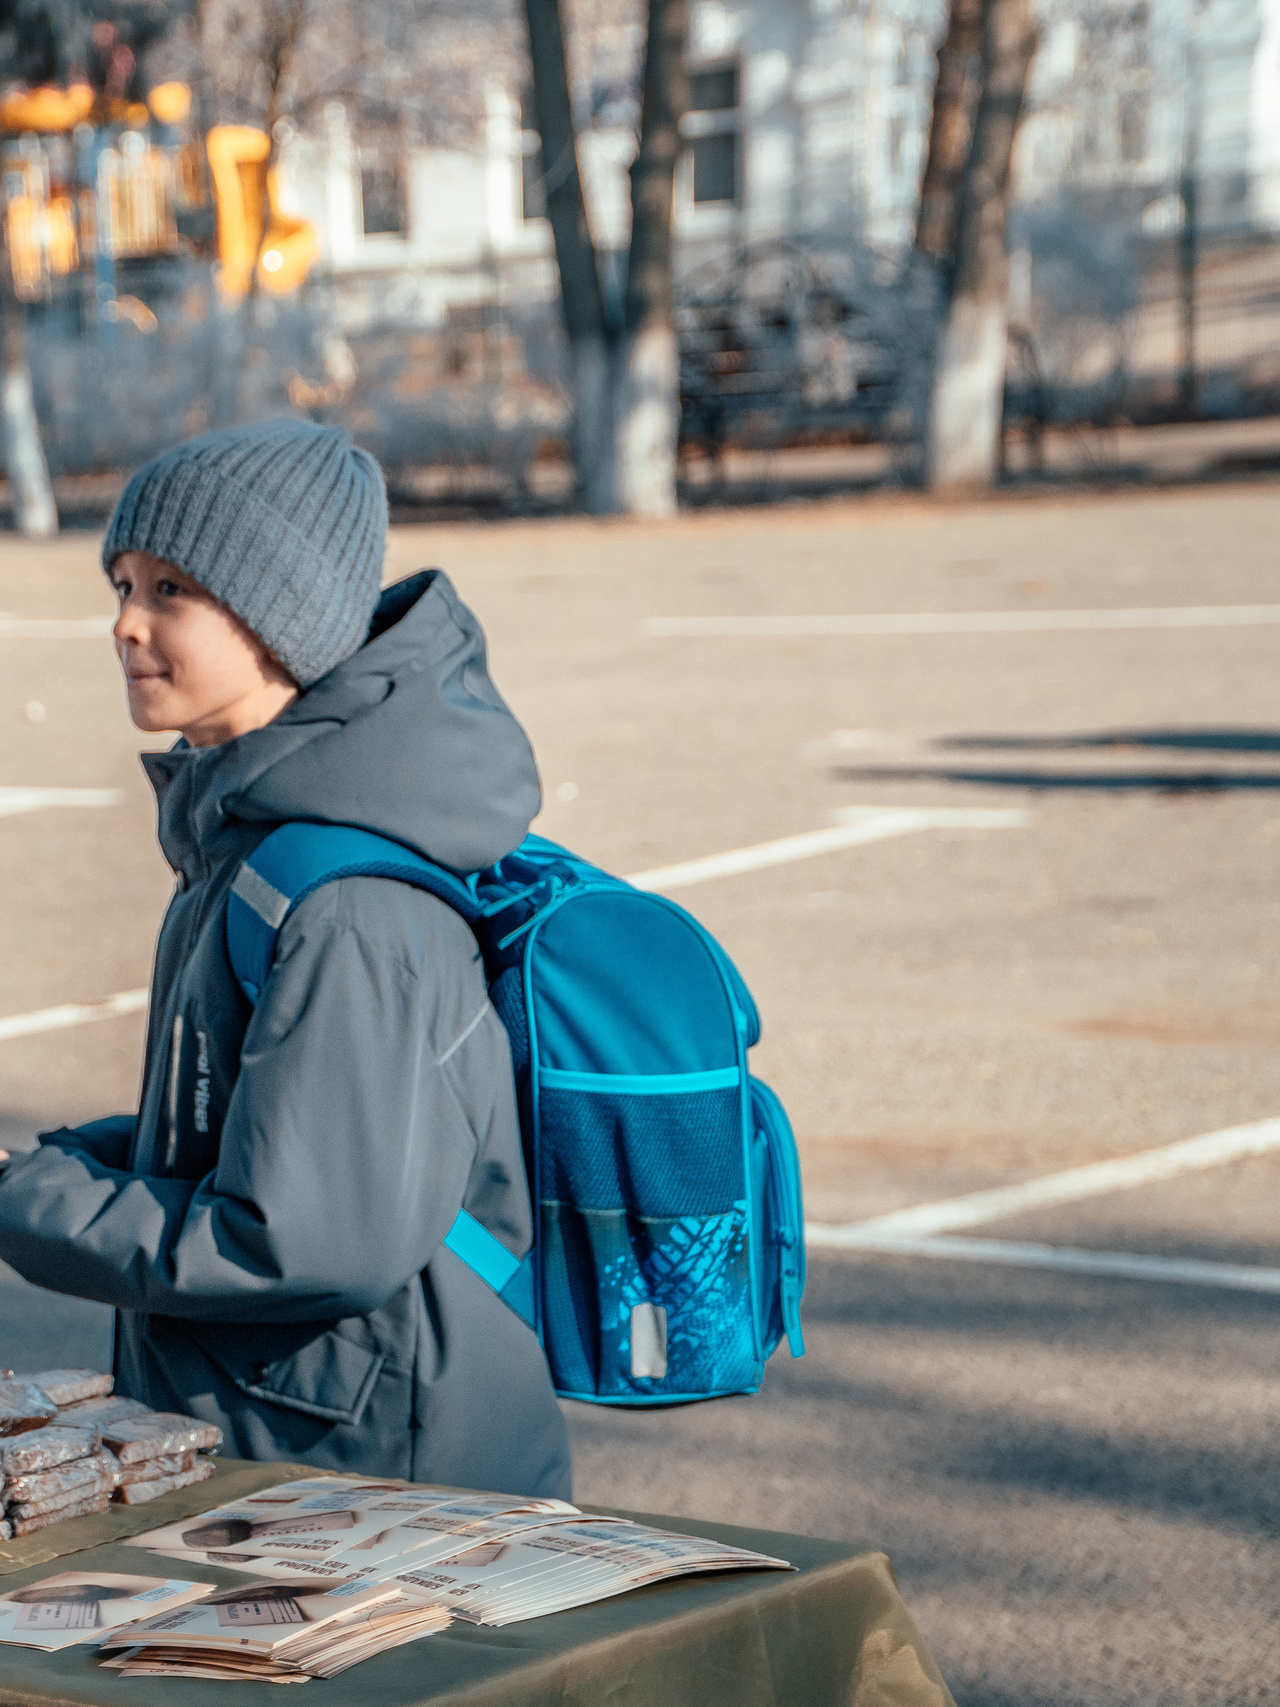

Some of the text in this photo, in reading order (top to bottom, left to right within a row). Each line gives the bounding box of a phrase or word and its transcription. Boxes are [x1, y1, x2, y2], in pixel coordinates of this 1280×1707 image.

[273, 1560, 338, 1577] БЛОКАДНЫЙ
[320, 1560, 351, 1570] ХЛЕБ
[429, 1574, 460, 1585] ХЛЕБ
